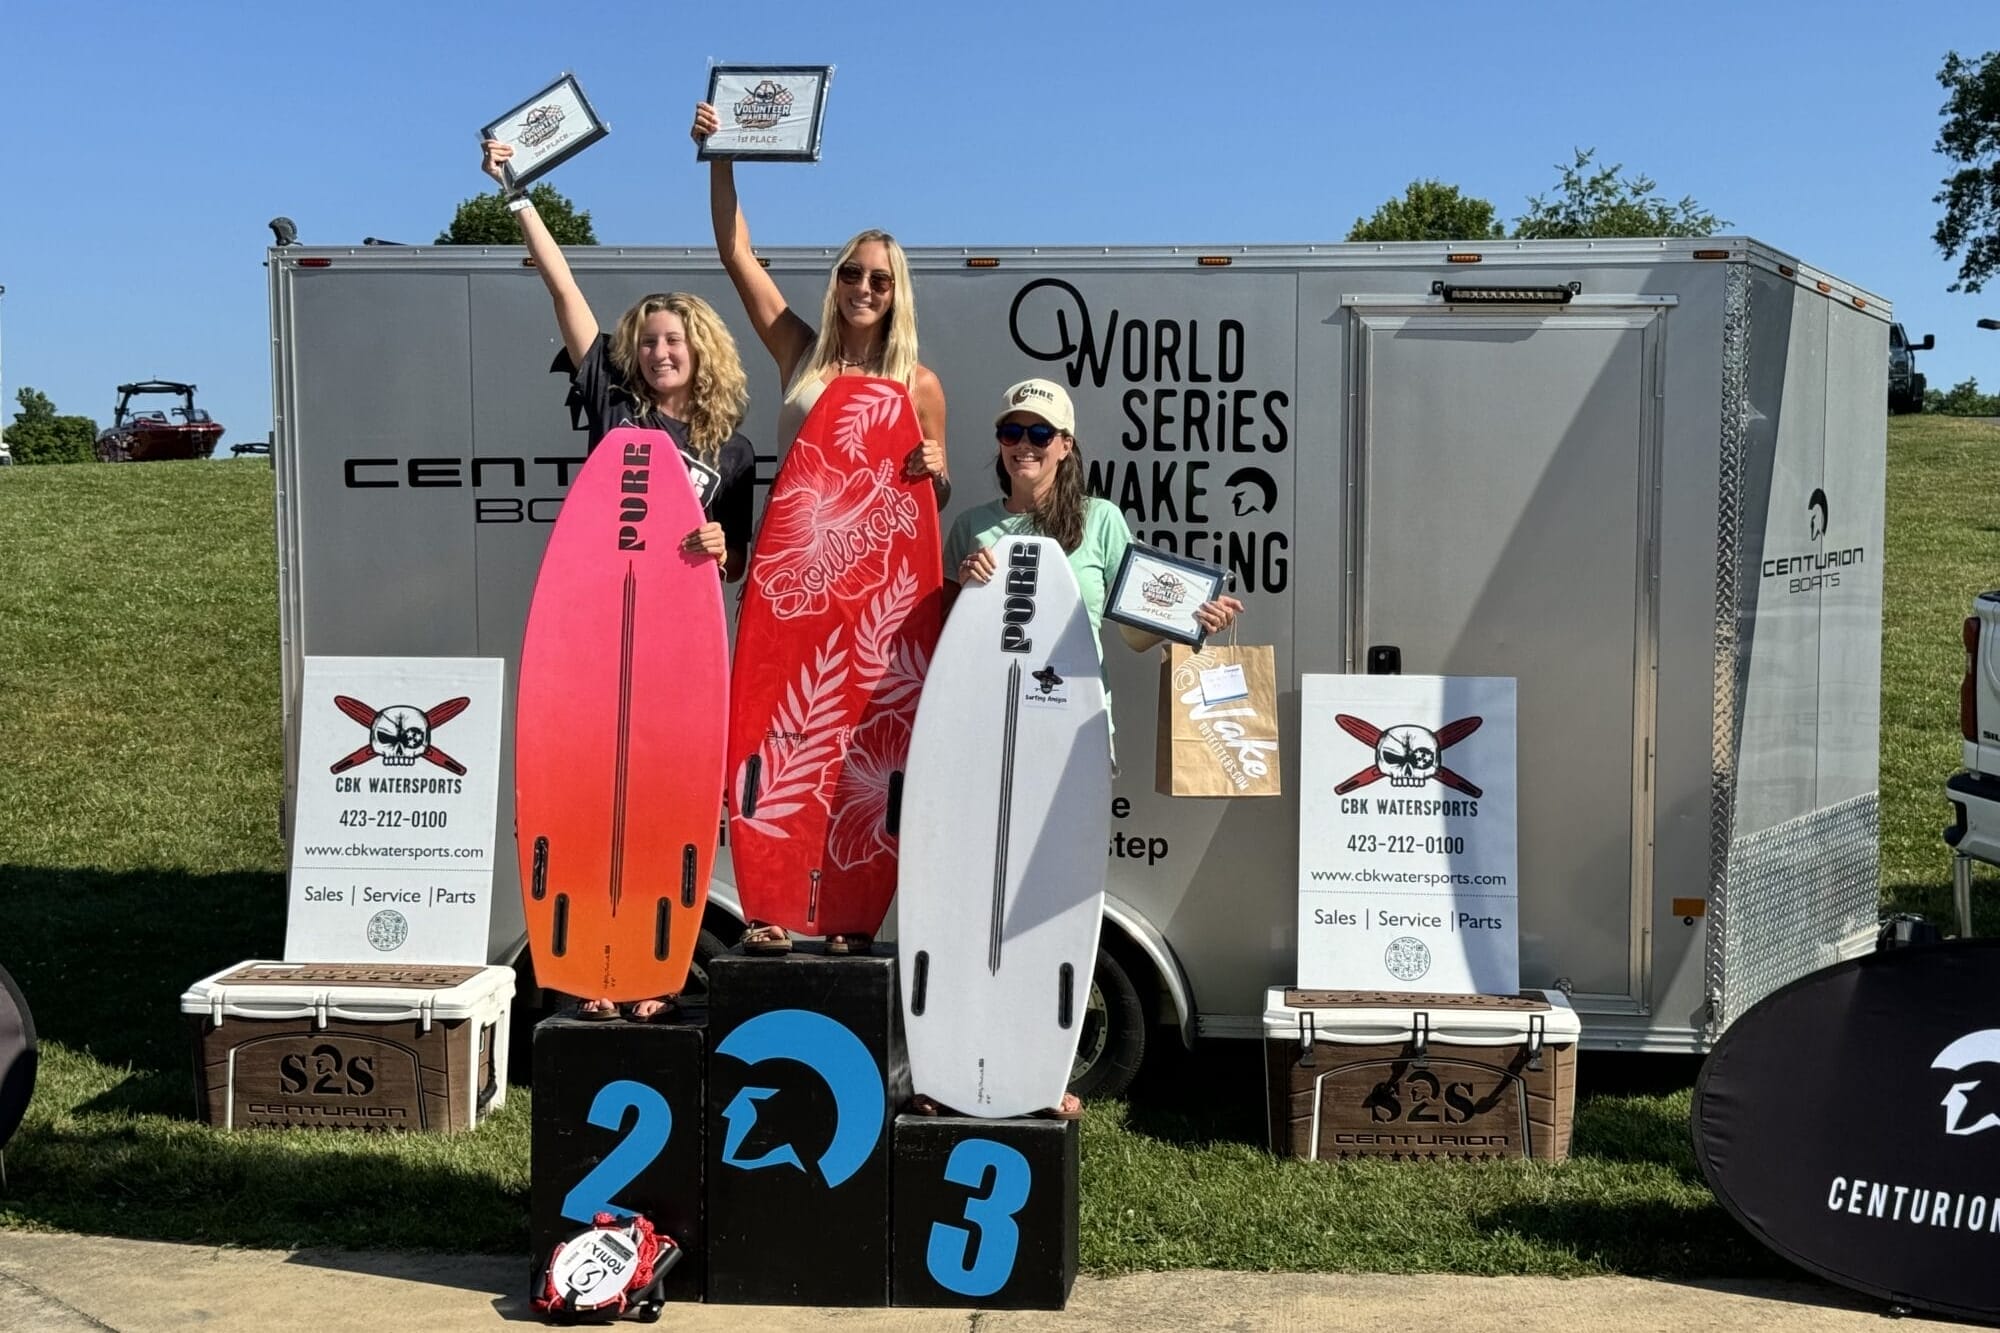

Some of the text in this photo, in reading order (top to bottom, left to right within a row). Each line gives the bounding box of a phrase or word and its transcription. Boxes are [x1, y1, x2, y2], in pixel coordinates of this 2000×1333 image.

[734, 103, 792, 117] VOLUNTEER
[749, 135, 778, 144] PLACE
[1009, 278, 1245, 387] WORLD
[618, 442, 653, 552] PURE
[760, 486, 920, 621] Soulcraft
[1762, 547, 1864, 578] CENTURION
[1788, 573, 1841, 594] BOATS
[1001, 541, 1042, 654] PURE
[766, 730, 809, 741] SUPER
[335, 777, 462, 794] CBK WATERSPORTS
[1341, 798, 1478, 817] CBK WATERSPORTS
[339, 810, 447, 828] 423-212-0100
[305, 844, 484, 861] www.cbkwatersports.com
[1108, 831, 1169, 866] tep
[1347, 834, 1464, 855] 423-212-0100
[1311, 868, 1506, 887] www.cbkwatersports.com
[304, 886, 476, 904] Sales Service Parts
[1314, 909, 1502, 930] Sales Service Parts
[279, 1044, 374, 1096] S2S
[1370, 1071, 1475, 1125] S2S
[247, 1103, 407, 1118] CENTURION
[1334, 1133, 1509, 1147] CENTURION
[560, 1079, 673, 1224] 2
[925, 1138, 1032, 1297] 3
[592, 1242, 626, 1276] Ronix
